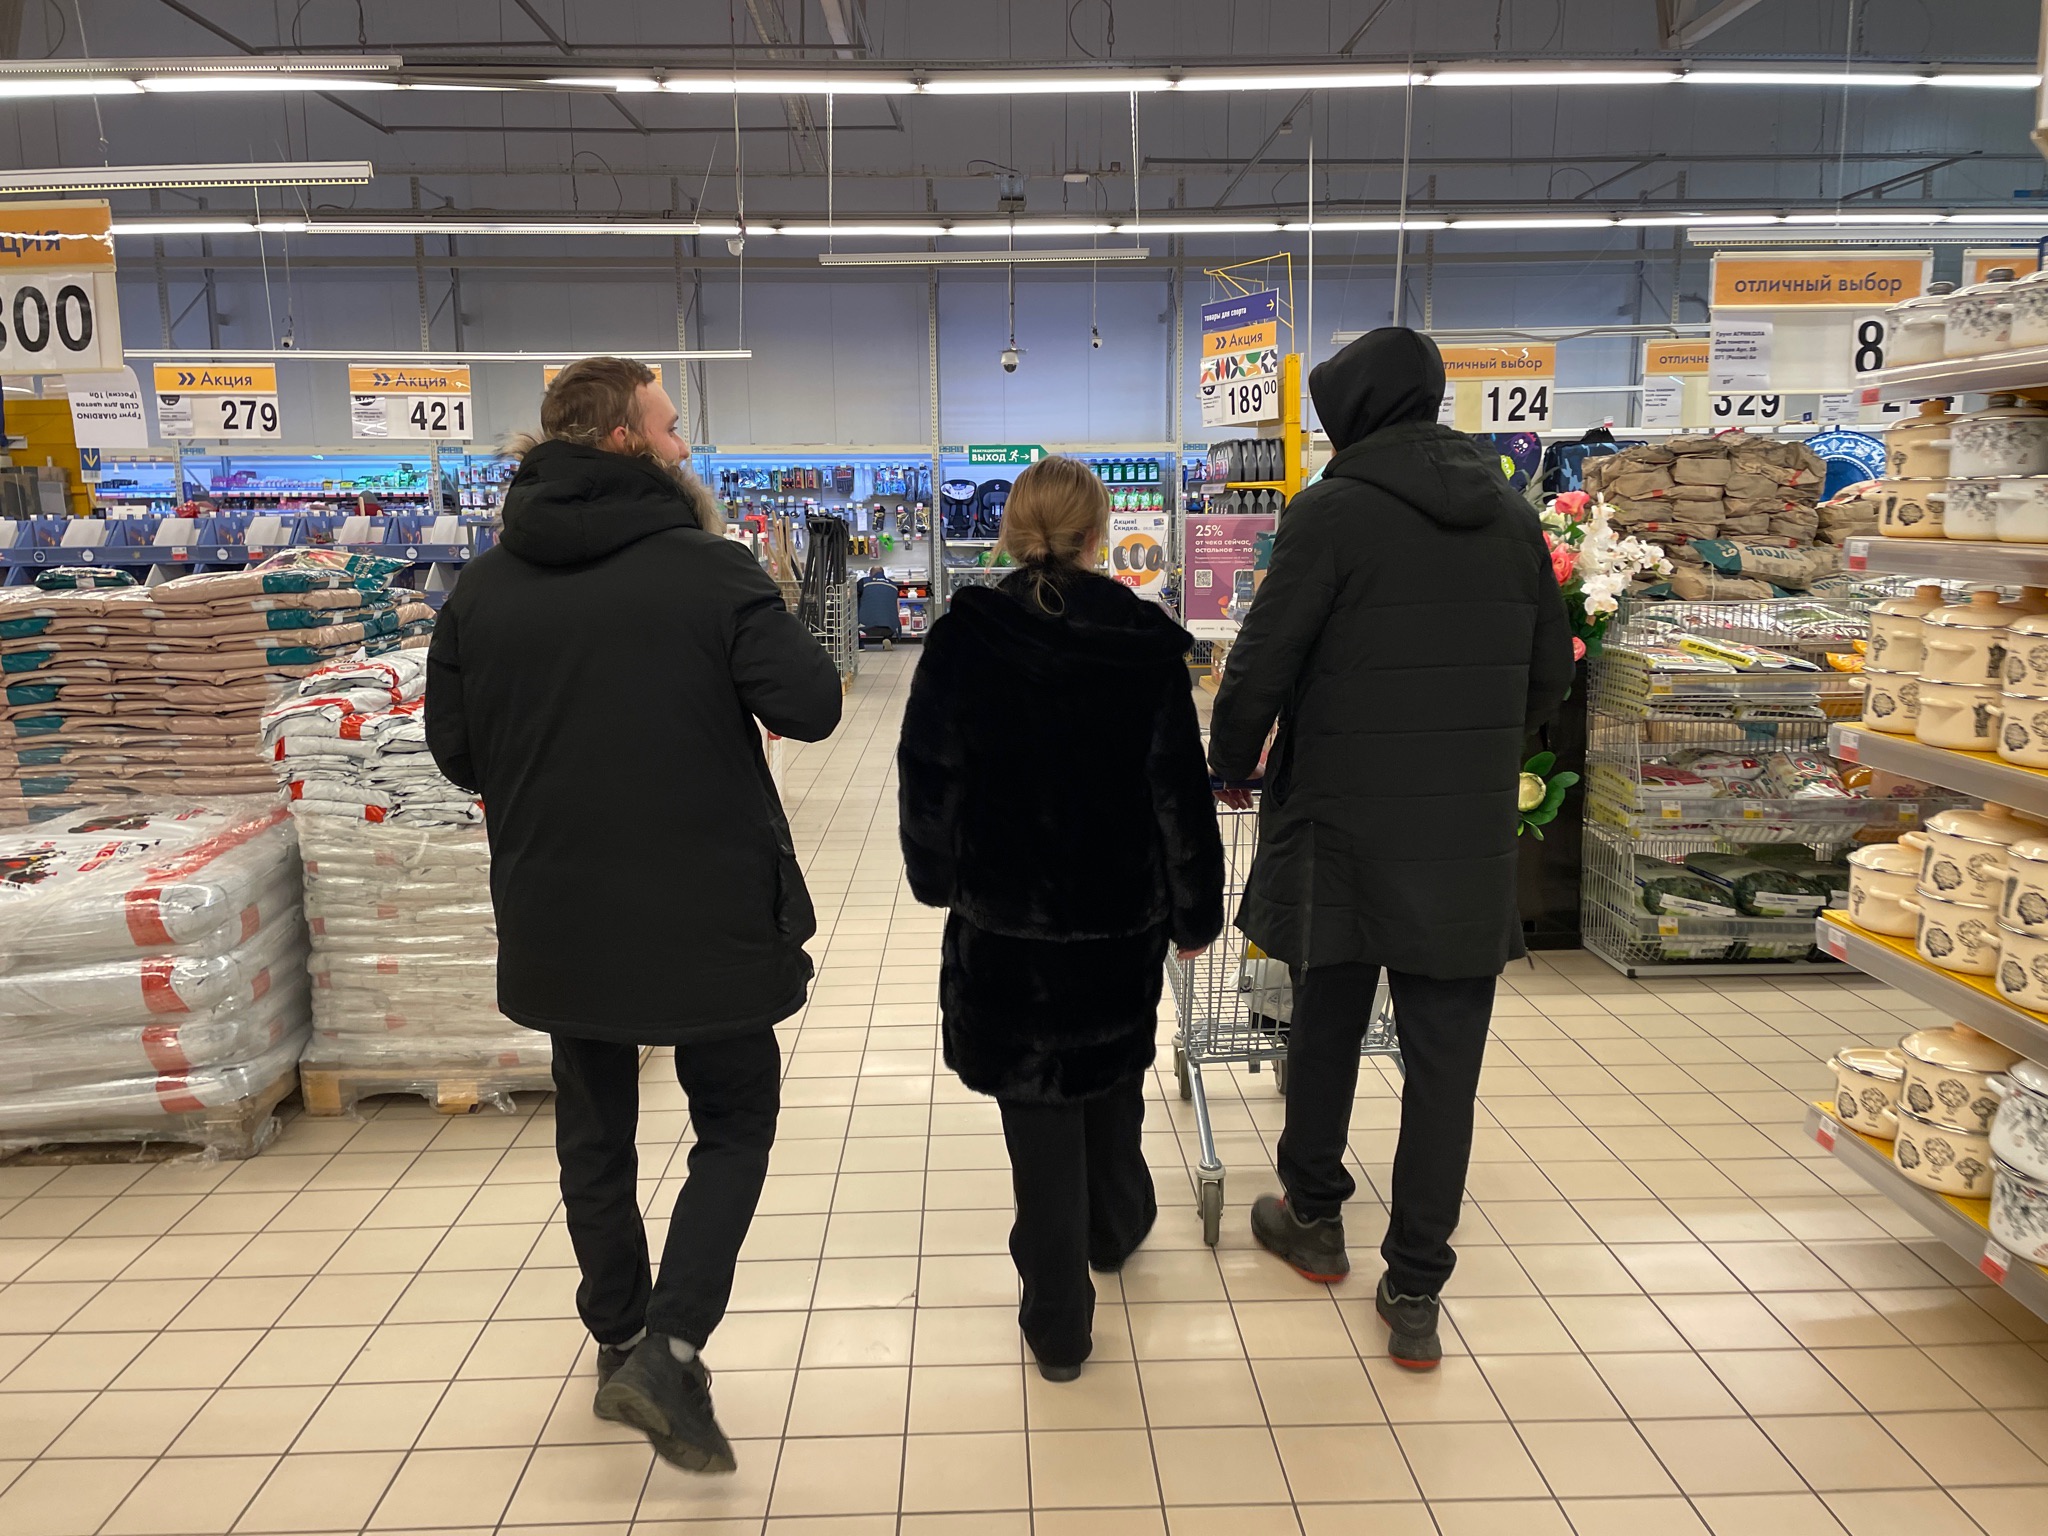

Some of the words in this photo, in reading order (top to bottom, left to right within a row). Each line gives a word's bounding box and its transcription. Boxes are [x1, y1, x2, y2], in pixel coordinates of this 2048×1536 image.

[0, 230, 61, 257] ция
[1734, 274, 1832, 293] отличный
[1838, 272, 1903, 296] выбор
[0, 284, 93, 353] 00
[1204, 312, 1221, 322] товары
[1221, 310, 1230, 319] для
[1230, 307, 1247, 318] спорта
[1229, 333, 1263, 348] Акция
[1443, 358, 1497, 369] тличный
[1501, 356, 1543, 371] выбор
[200, 371, 253, 388] Акция
[395, 372, 447, 389] Акция
[1228, 383, 1262, 416] 189
[1264, 379, 1277, 395] 00
[1487, 386, 1549, 421] 124
[76, 412, 118, 420] GIARDINO
[221, 400, 278, 432] 279
[411, 401, 465, 431] 421
[971, 453, 1006, 463] ВЫХОД
[1195, 524, 1224, 537] 25%
[1224, 538, 1251, 546] сейчас,
